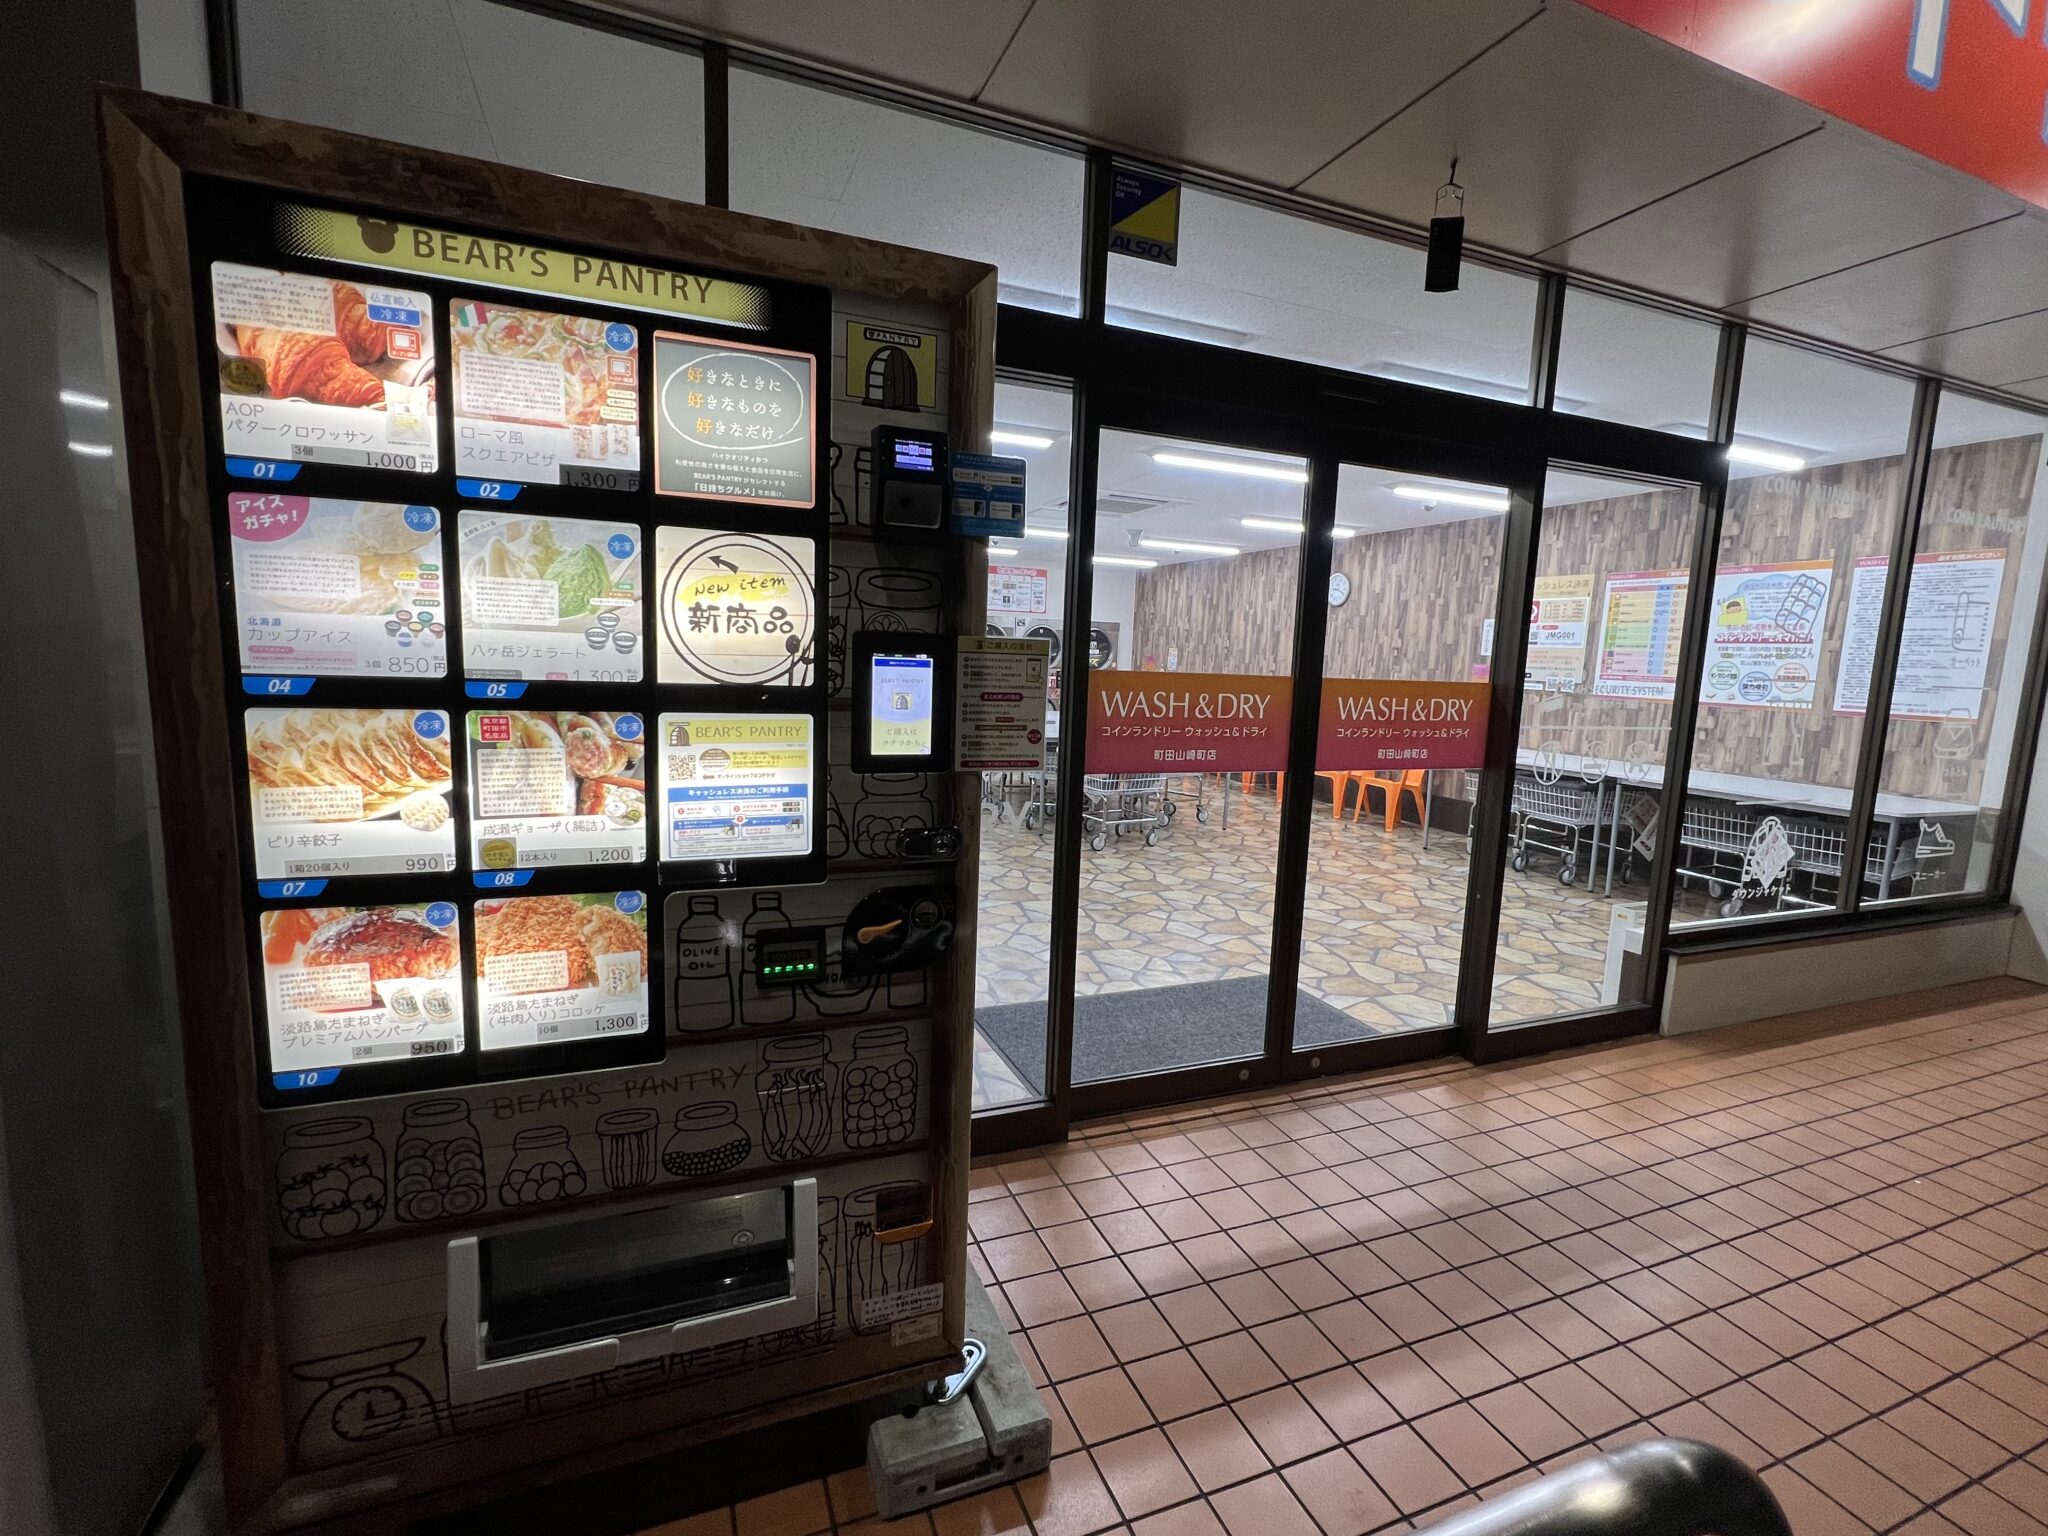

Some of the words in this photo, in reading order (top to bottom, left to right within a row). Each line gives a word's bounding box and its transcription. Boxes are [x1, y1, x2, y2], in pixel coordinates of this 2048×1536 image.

[1110, 235, 1174, 261] ALSOK
[413, 229, 550, 278] BEAR'S
[573, 257, 713, 303] PANTRY
[370, 292, 417, 307] 仏直輸入
[380, 308, 409, 322] 冷凍
[608, 331, 631, 345] 冷凍
[876, 331, 917, 346] PANTRY
[687, 367, 782, 392] 好きなときに
[225, 402, 265, 417] AOP
[687, 391, 782, 417] 好きなものを
[227, 419, 374, 444] バタークロワッサン
[460, 427, 525, 445] ローマ風
[695, 417, 775, 441] 好きなだけ
[294, 445, 314, 456] 3個
[366, 452, 417, 470] 1,000
[462, 446, 555, 467] スクエアピザ
[253, 463, 276, 479] 01
[566, 471, 617, 488] 1,300
[479, 484, 500, 497] 02
[236, 495, 284, 513] アイス
[243, 509, 297, 530] ガチャ！
[407, 512, 433, 524] 冷凍
[609, 541, 632, 552] 冷凍
[695, 583, 730, 596] New
[740, 576, 786, 590] item
[247, 617, 282, 627] 北海道
[688, 601, 794, 635] 新商品
[248, 629, 352, 643] カップアイス
[1545, 631, 1575, 640] JMG001
[471, 645, 586, 661] 八ヶ岳ジェラート
[987, 642, 1032, 652] ご購入の流れ
[365, 660, 381, 669] 3個
[388, 657, 430, 673] 850
[434, 663, 446, 673] 円
[268, 680, 291, 693] 04
[486, 684, 507, 697] 05
[1594, 684, 1630, 696] ECURITY
[416, 720, 442, 732] 冷凍
[617, 722, 640, 733] 冷凍
[695, 726, 743, 738] BEAR'S
[750, 726, 803, 738] PANTRY
[1101, 725, 1181, 737] コインランドリー
[1336, 727, 1400, 737] コインランドリー
[1153, 749, 1217, 761] 町田山崎町店
[1377, 749, 1428, 759] 町田山崎町店
[483, 819, 607, 837] 成瀬ギョーザ（腸詰）
[267, 834, 342, 848] ピリ辛餃子
[520, 852, 557, 863] 12本入り
[588, 849, 630, 862] 1,200
[288, 862, 350, 874] 1箱20個入り
[405, 858, 438, 870] 990
[494, 873, 515, 885] 08
[282, 882, 305, 895] 07
[618, 896, 640, 907] 冷凍
[429, 909, 453, 920] 冷凍
[683, 947, 720, 957] OLIVE
[688, 961, 714, 970] OIL
[488, 994, 579, 1015] 淡路島たまねぎ
[281, 1013, 385, 1035] 淡路島たまねぎ
[539, 1025, 558, 1034] 10個
[595, 1016, 634, 1031] 1,300
[283, 1023, 428, 1048] プレミアムハンバーグ
[355, 1047, 372, 1055] 2個
[412, 1041, 447, 1055] 950
[298, 1073, 317, 1086] 10
[493, 1081, 602, 1120] BEAR'S
[623, 1065, 749, 1100] PANTRY
